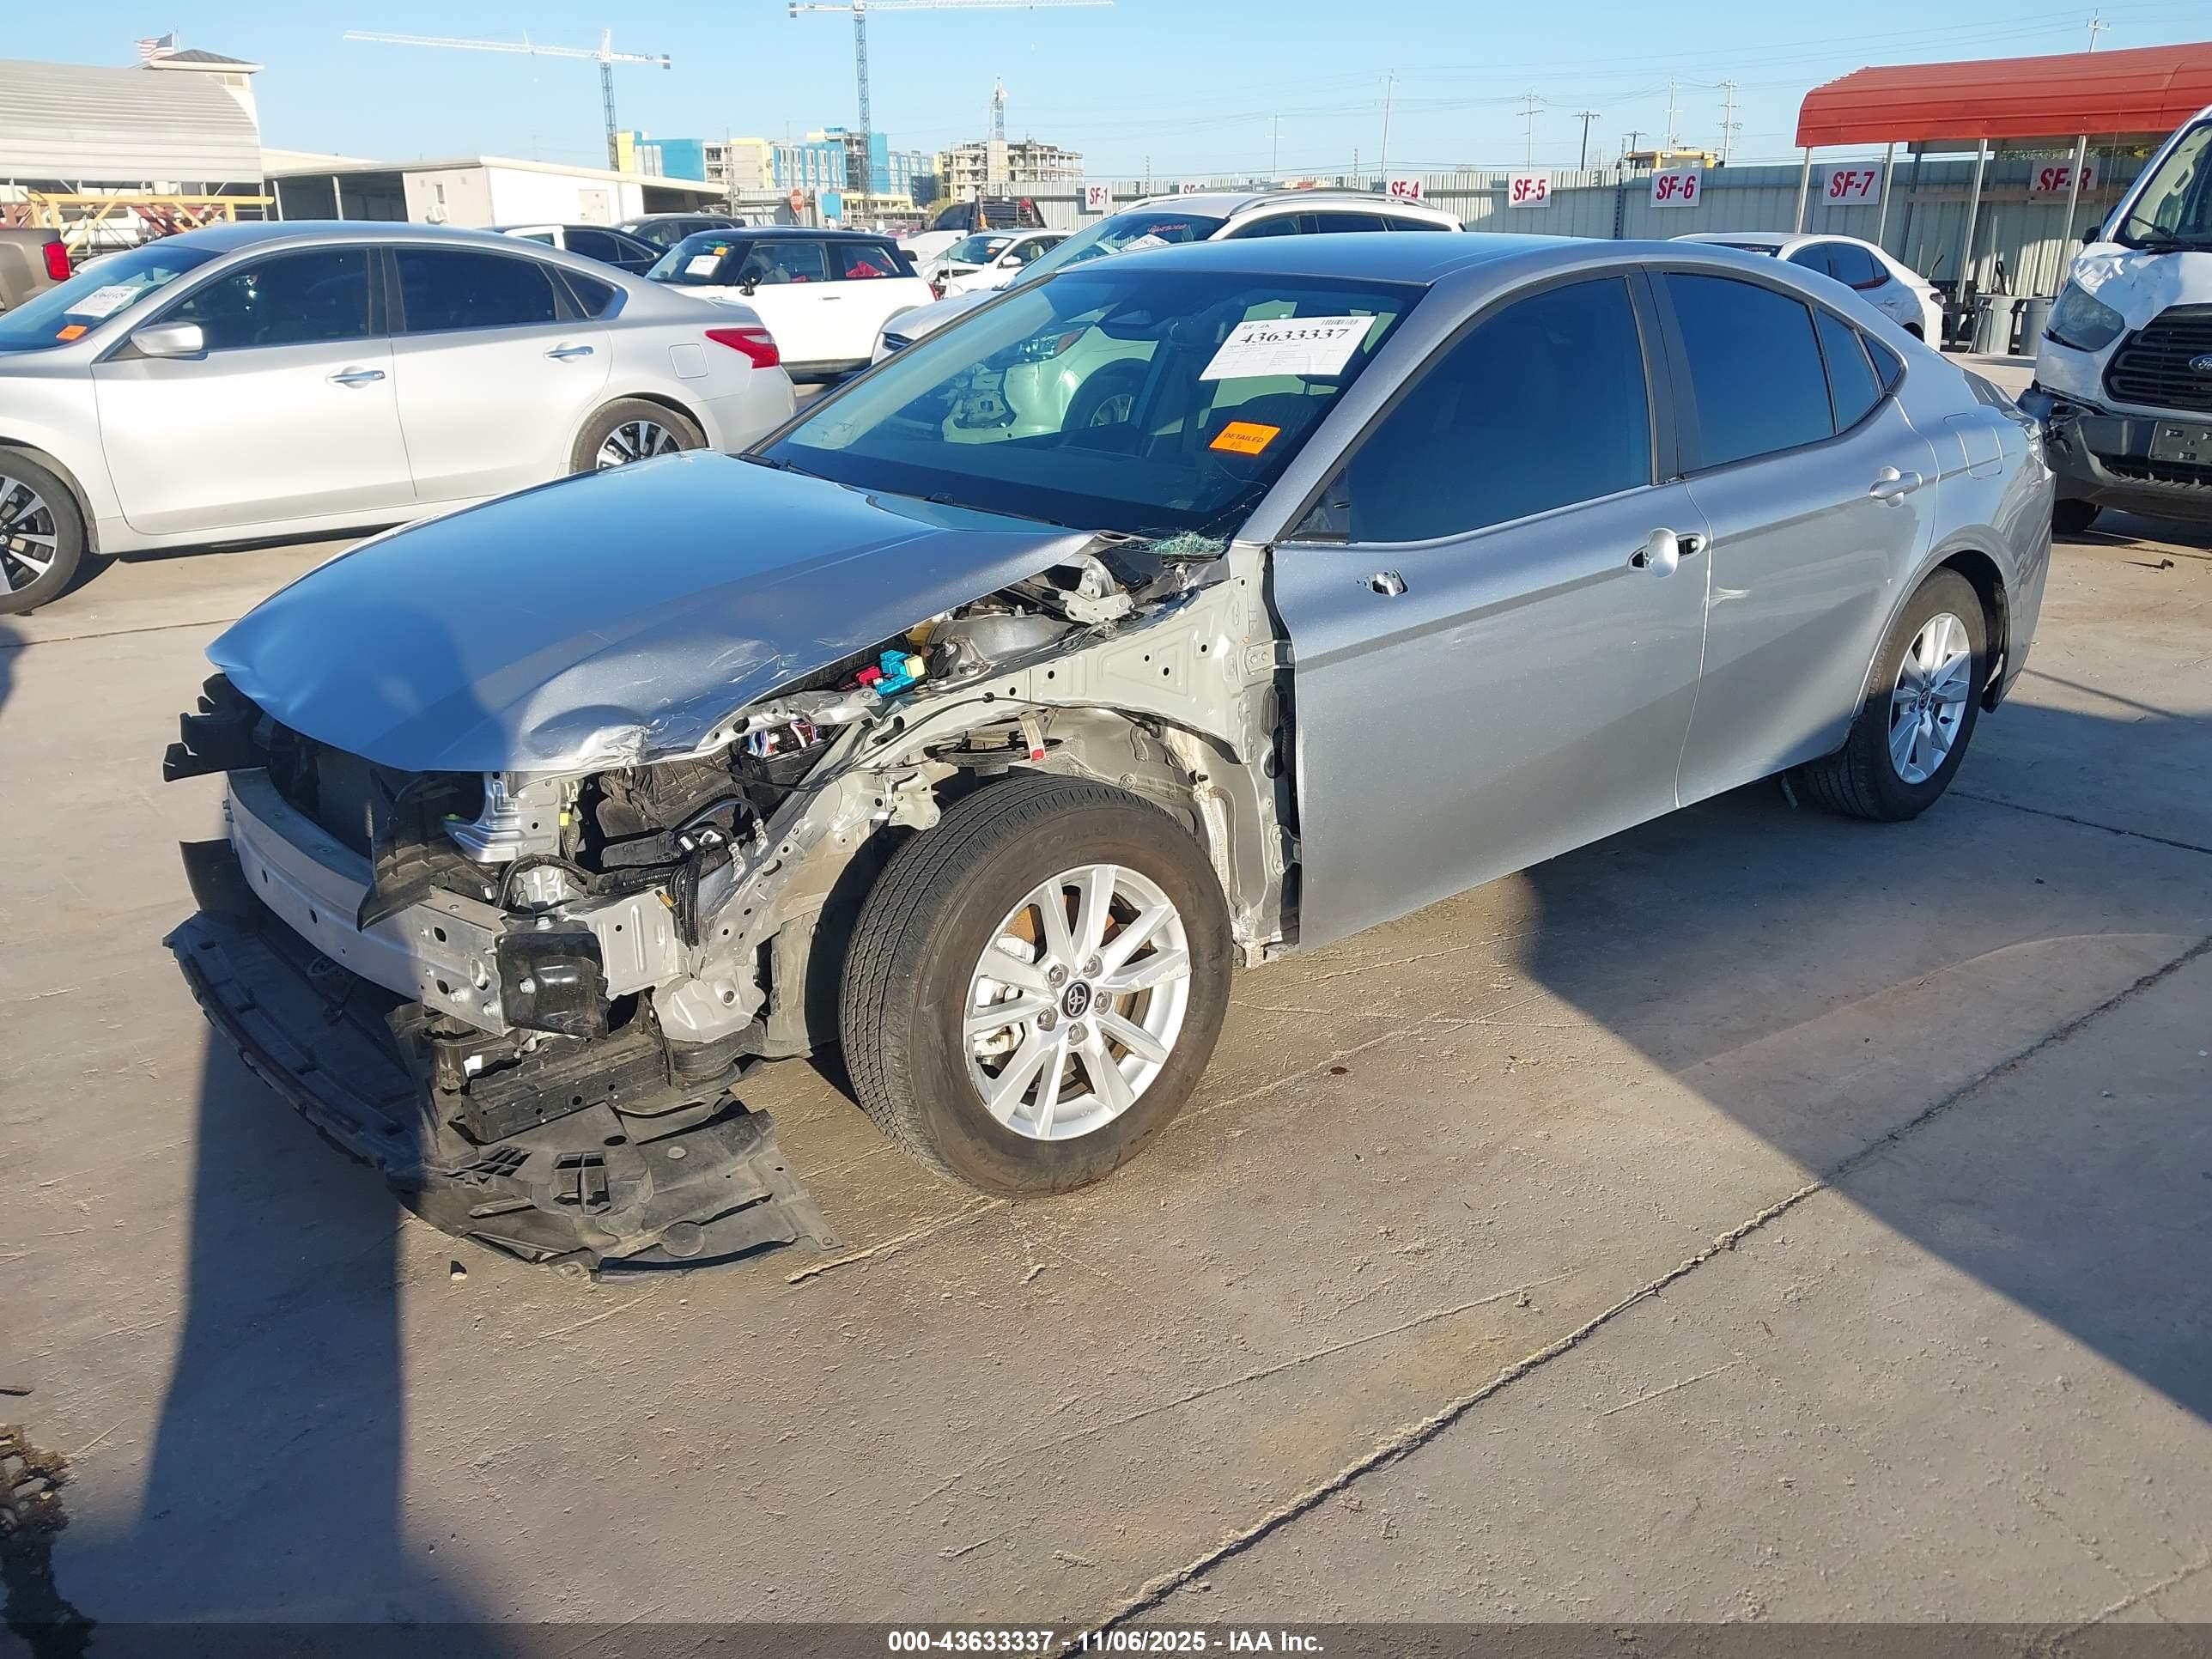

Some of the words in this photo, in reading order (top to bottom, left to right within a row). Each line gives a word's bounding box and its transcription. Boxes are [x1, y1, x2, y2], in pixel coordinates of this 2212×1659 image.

[1391, 181, 1419, 199] SF-4
[1513, 179, 1547, 201] SF-5
[1656, 175, 1697, 200] SF-6
[1832, 171, 1874, 197] SF-7
[1089, 187, 1108, 205] SF-1
[1240, 328, 1350, 343] 43633337
[2198, 358, 2212, 370] Fo
[1224, 433, 1264, 443] DETAILED
